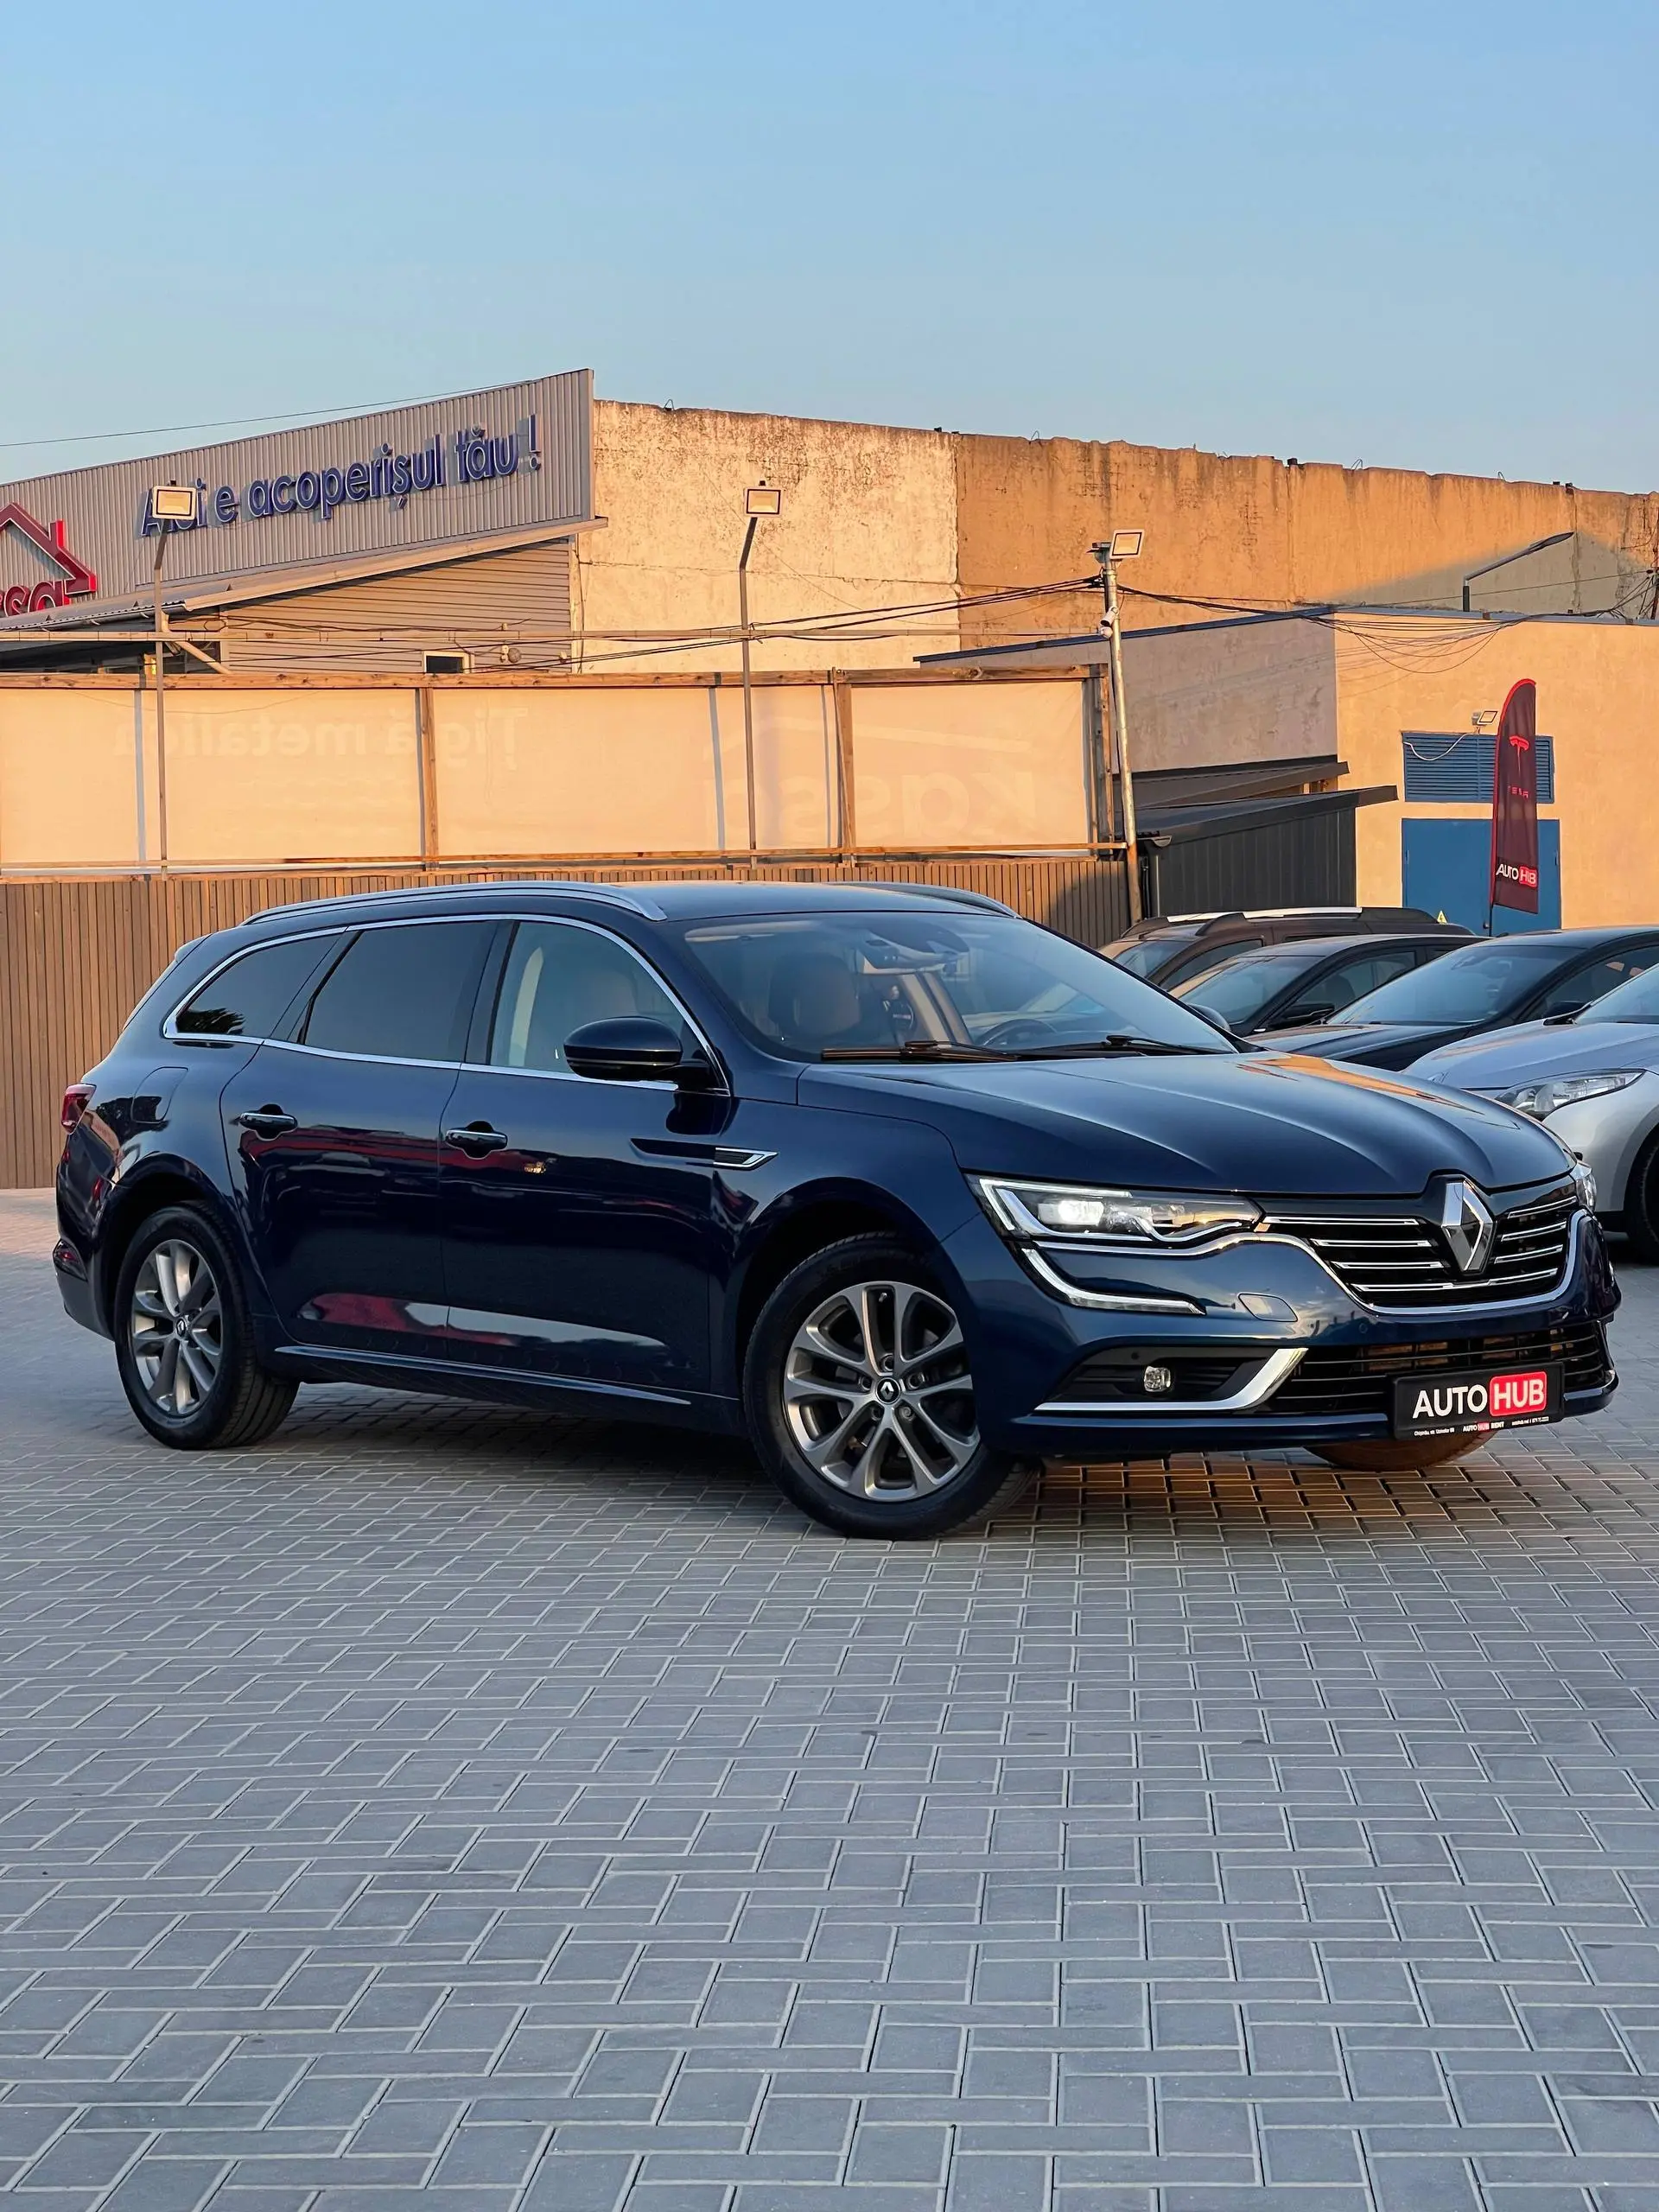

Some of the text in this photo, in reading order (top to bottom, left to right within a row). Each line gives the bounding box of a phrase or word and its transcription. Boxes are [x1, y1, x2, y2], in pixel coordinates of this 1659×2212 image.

[214, 486, 241, 524] e
[248, 433, 447, 519] acoperișul
[454, 421, 519, 482] tău
[1495, 863, 1519, 880] AUTO
[1412, 1379, 1545, 1419] AUTO HUB
